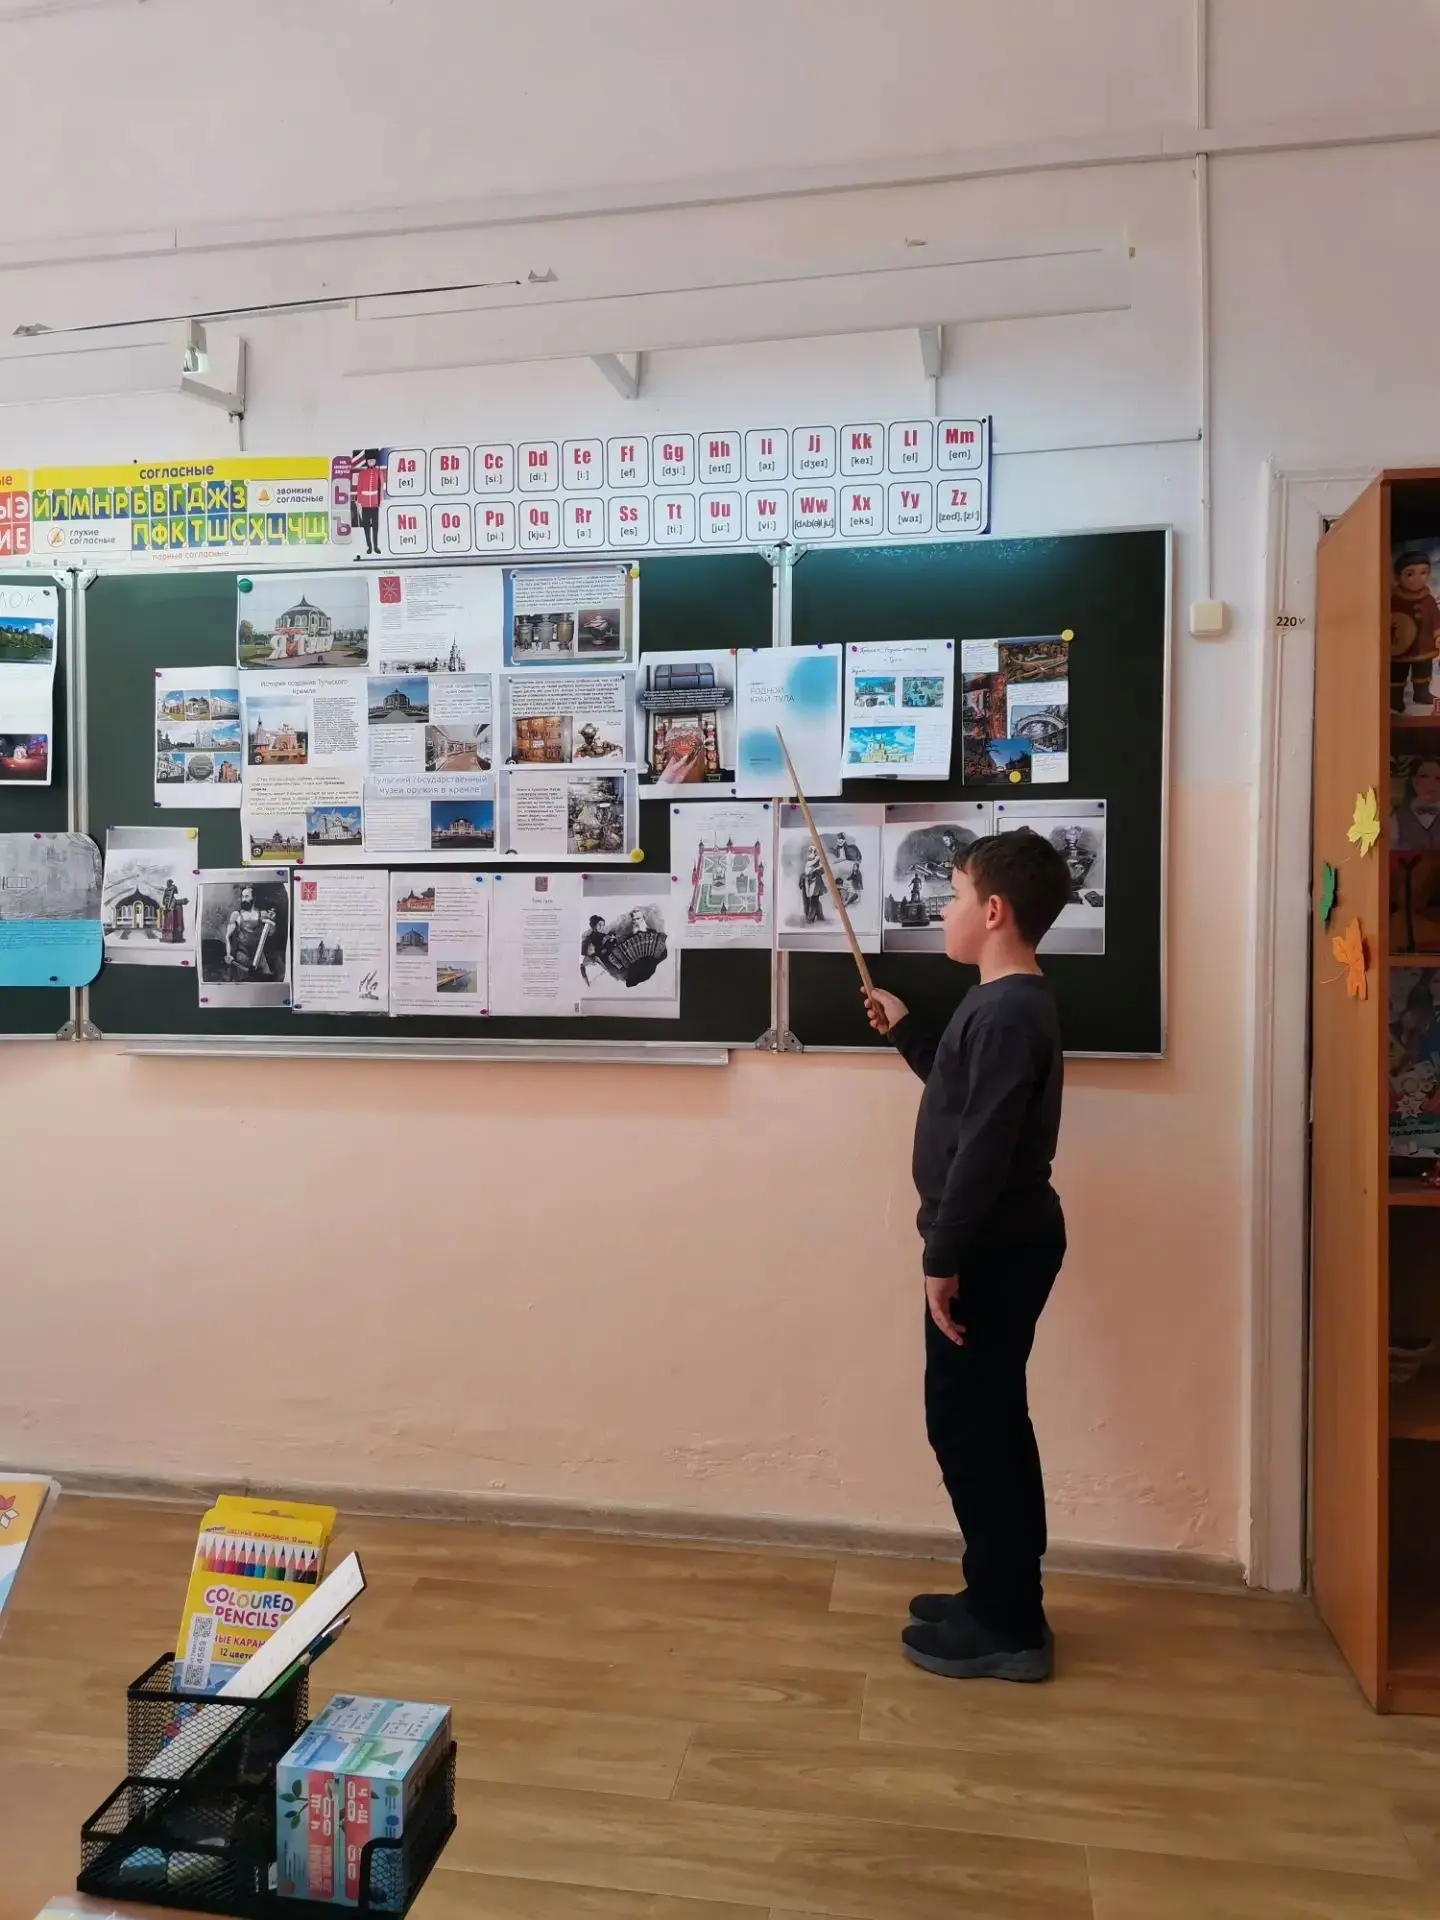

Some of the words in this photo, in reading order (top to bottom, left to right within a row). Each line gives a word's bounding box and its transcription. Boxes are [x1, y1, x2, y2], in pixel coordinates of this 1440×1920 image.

[397, 457, 416, 473] Aa
[440, 455, 460, 471] Bb
[484, 453, 504, 470] Cc
[528, 450, 548, 467] Dd
[574, 448, 592, 465] Ee
[620, 446, 635, 463] Ff
[663, 443, 684, 462] Gg
[709, 440, 730, 458] Hh
[761, 438, 772, 455] Ii
[808, 435, 821, 453] Jj
[851, 432, 872, 450] Kk
[904, 429, 918, 447] Ll
[945, 428, 974, 444] Mm
[949, 449, 971, 460] [em]
[140, 464, 214, 479] согласные
[277, 487, 313, 496] звонкие
[276, 495, 324, 504] согласные
[397, 514, 417, 530] Nn
[441, 513, 461, 529] Oo
[485, 510, 505, 528] Pp
[529, 508, 549, 526] Qq
[575, 507, 592, 524] Rr
[619, 505, 638, 522] Ss
[667, 503, 682, 520] Tt
[710, 501, 731, 517] Uu
[757, 499, 777, 515] Vv
[800, 497, 828, 514] Ww
[852, 494, 871, 511] Xx
[901, 490, 920, 509] Yy
[951, 489, 967, 507] Zz
[69, 529, 99, 537] глухие
[620, 526, 638, 537] [es]
[70, 536, 115, 545] согласные
[152, 552, 182, 561] парные
[185, 550, 229, 559] согласные
[1276, 616, 1297, 627] 220
[206, 1588, 293, 1613] COLOURED
[215, 1606, 280, 1628] PENCILS
[220, 1647, 228, 1657] 12
